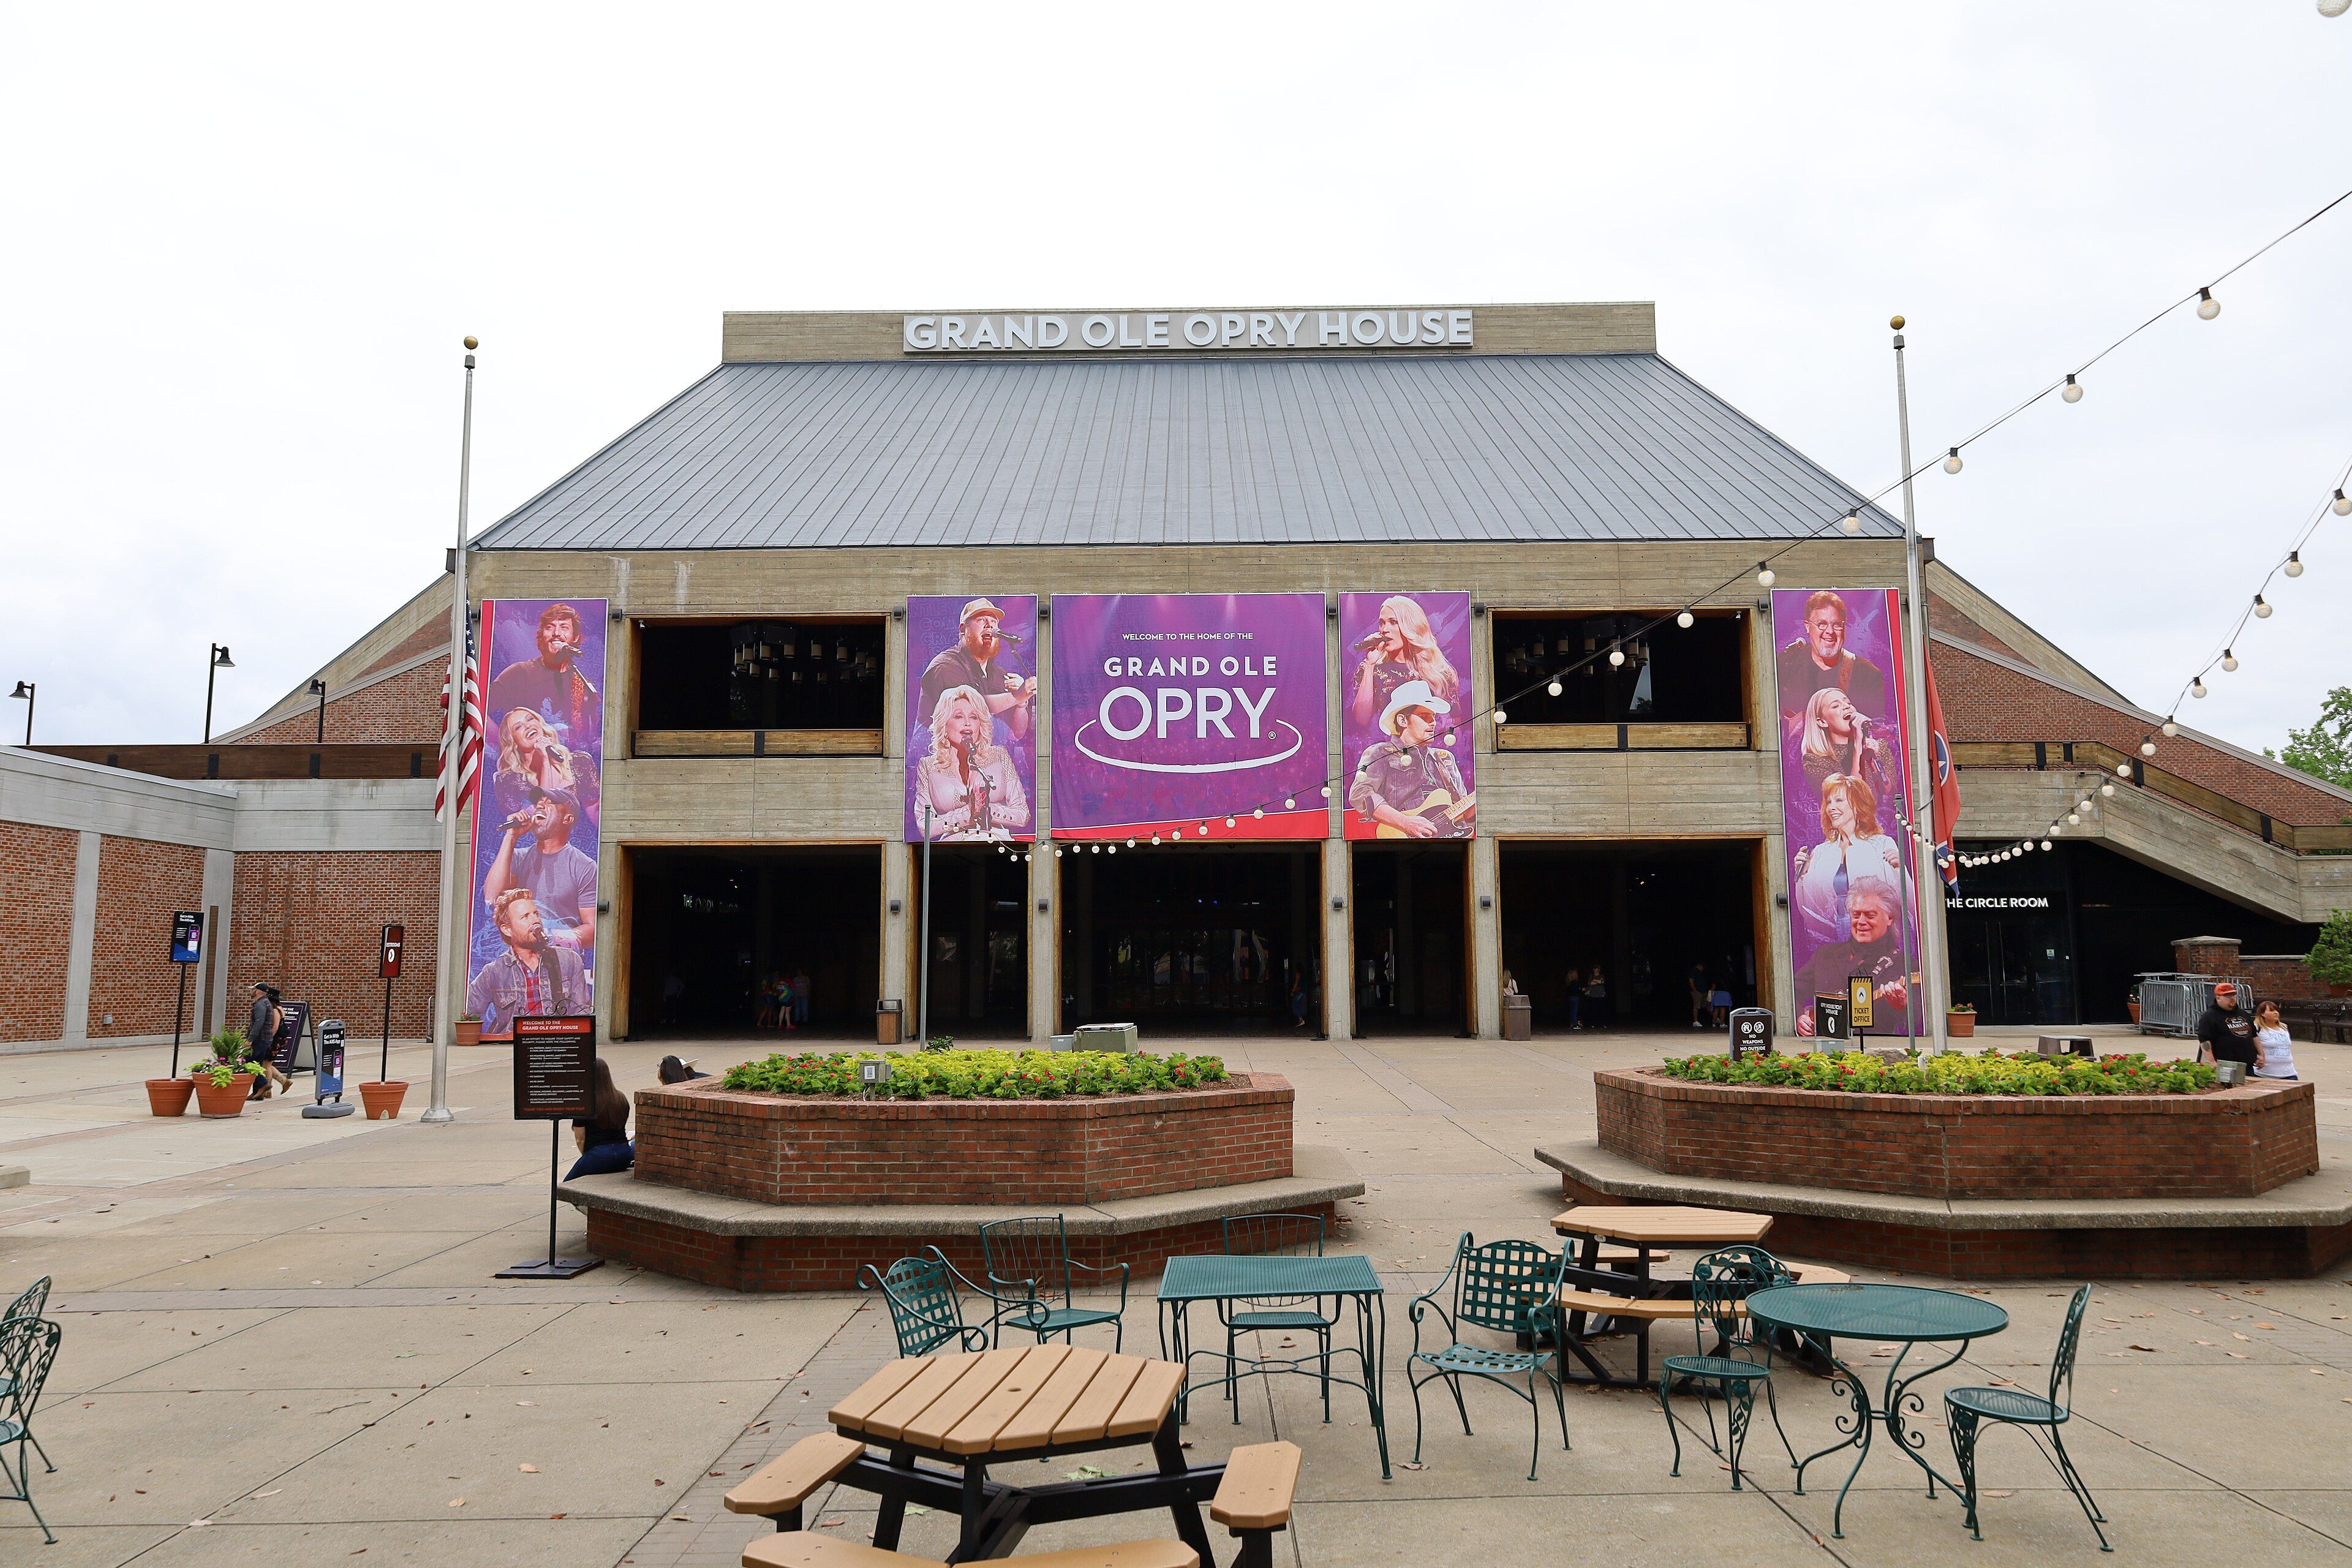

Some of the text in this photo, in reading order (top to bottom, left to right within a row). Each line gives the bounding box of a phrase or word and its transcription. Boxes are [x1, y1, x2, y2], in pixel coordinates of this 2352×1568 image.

[905, 310, 1472, 349] GRAND OLE OPRY HOUSE
[1103, 655, 1278, 677] GRAND OLE
[1099, 686, 1277, 741] OPRY
[1945, 897, 2049, 908] HE CIRCLE ROOM
